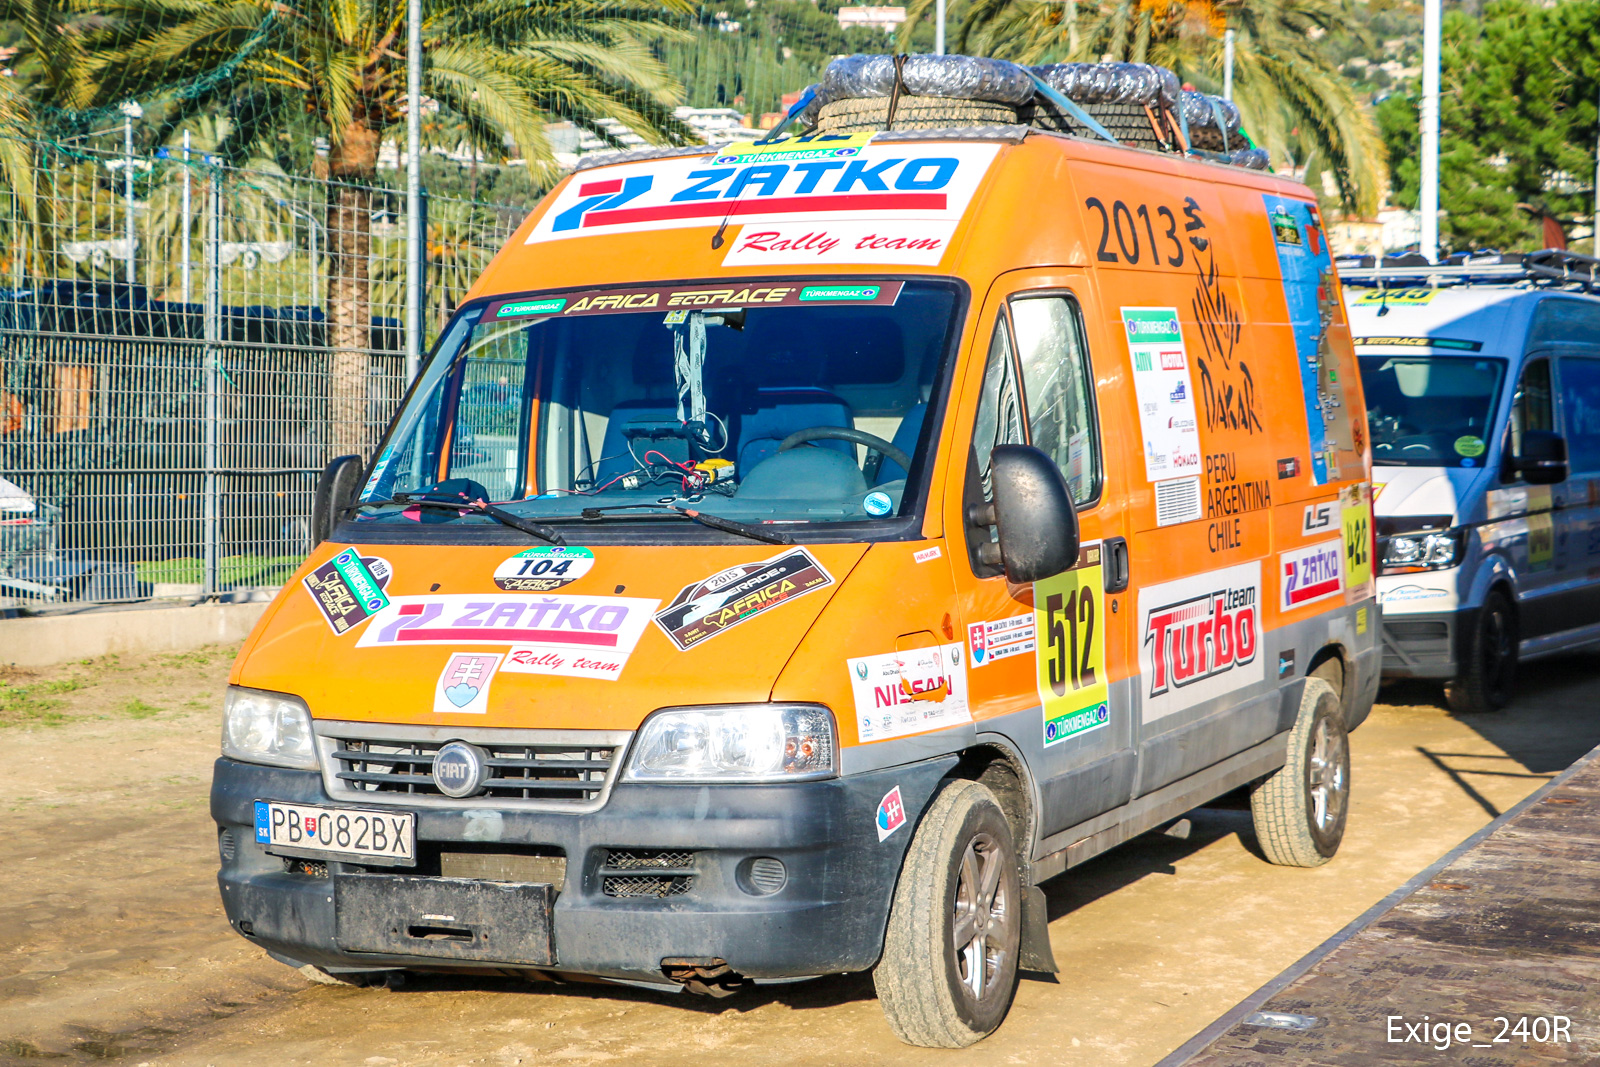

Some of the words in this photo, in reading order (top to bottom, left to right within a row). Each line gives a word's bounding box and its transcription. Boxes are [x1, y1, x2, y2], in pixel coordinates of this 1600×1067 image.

[741, 149, 835, 163] TÜRKMENGAZ
[737, 231, 840, 256] Rally
[855, 234, 942, 251] team
[1085, 196, 1184, 268] 2013
[513, 302, 560, 313] TÜRKMENGAZ
[564, 292, 660, 315] AFRICA
[805, 289, 861, 298] TÜRKMENGAZ
[1197, 355, 1263, 435] DAKAR
[1205, 452, 1236, 485] PERU
[1207, 480, 1272, 519] ARGENTINA
[1208, 518, 1242, 553] CHILE
[516, 559, 574, 576] 104
[451, 597, 630, 632] ZAŤKO
[719, 579, 797, 625] AFRICA
[1046, 585, 1097, 697] 512
[1148, 597, 1256, 693] Turbo
[508, 650, 565, 669] Rally
[572, 657, 621, 672] team
[1057, 708, 1098, 736] TÜRKMENGAZ
[438, 761, 467, 779] FIAT
[258, 827, 269, 837] SK
[271, 807, 303, 843] PB
[318, 812, 407, 854] 082BX
